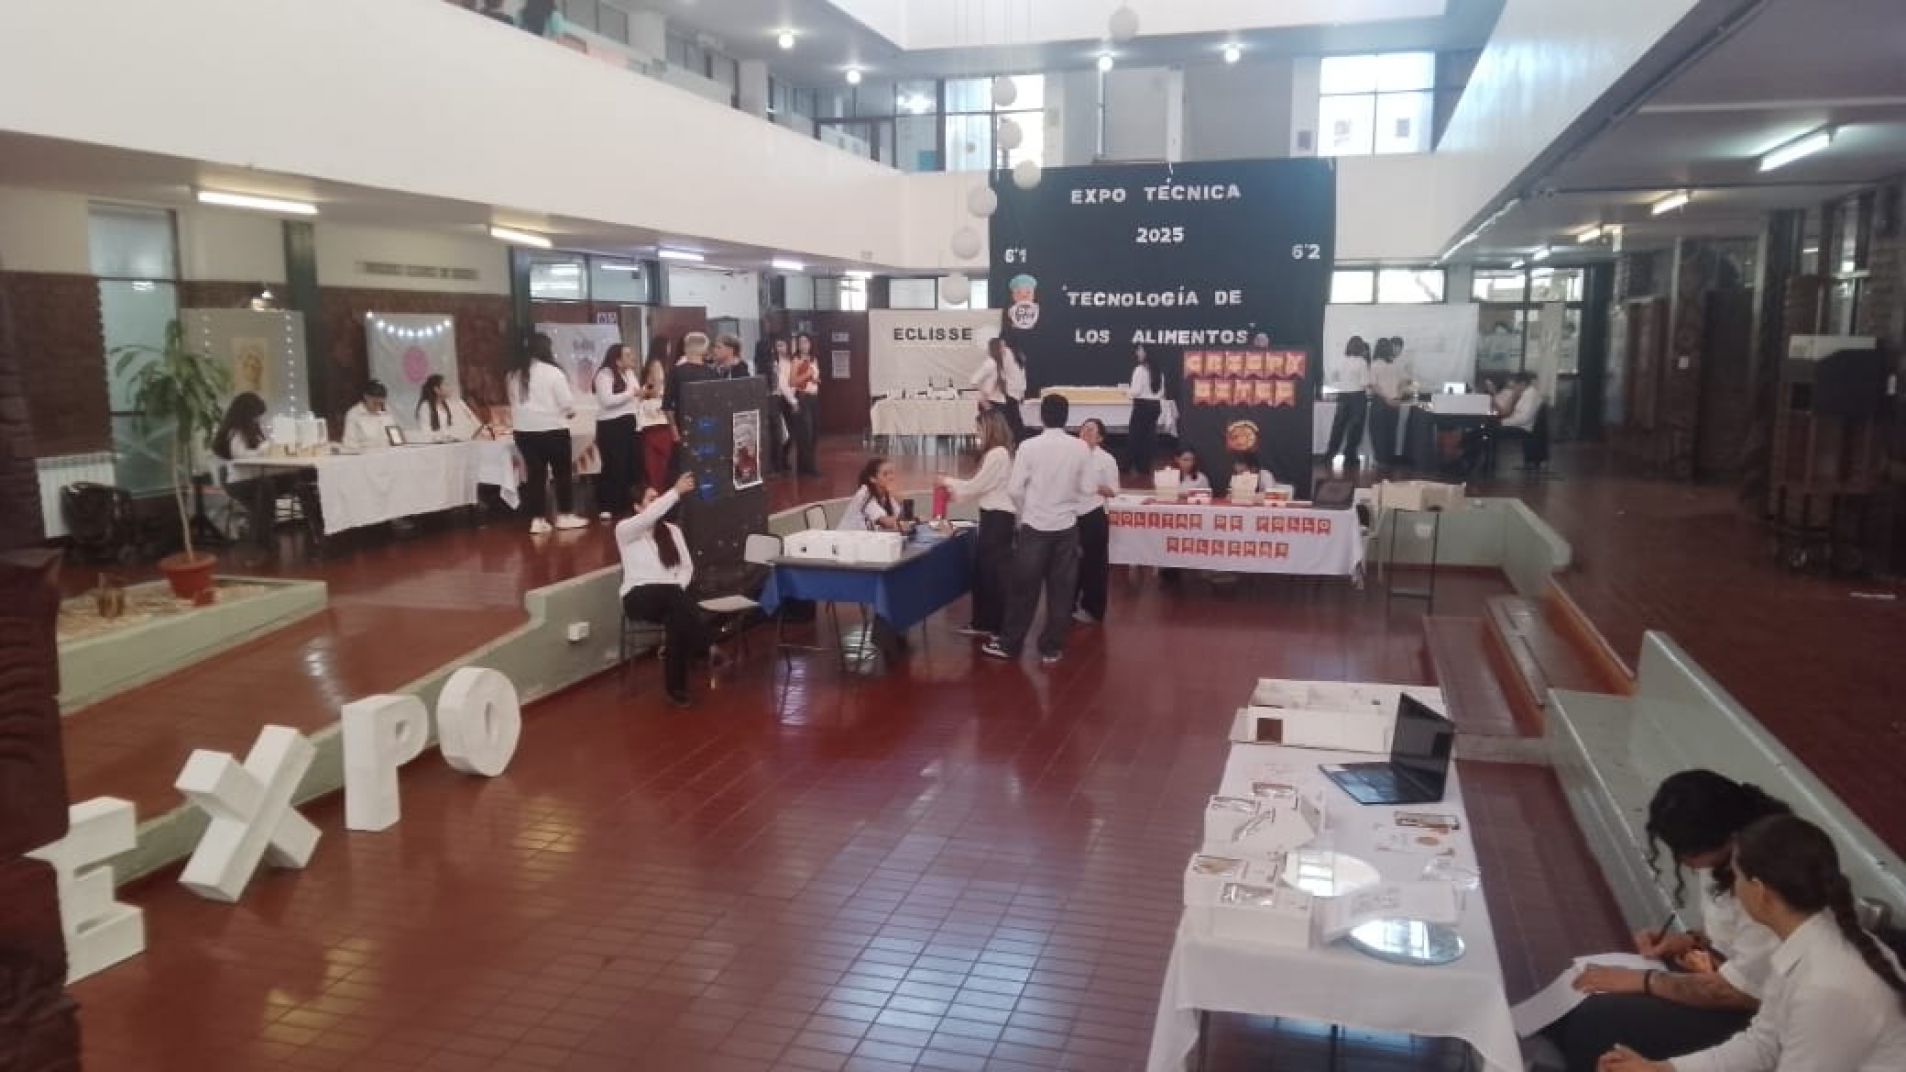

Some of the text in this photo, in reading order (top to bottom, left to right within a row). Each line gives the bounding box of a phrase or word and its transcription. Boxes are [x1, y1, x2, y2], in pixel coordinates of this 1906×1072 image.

[1071, 177, 1241, 205] EXPO TÉCNICA
[1135, 227, 1185, 243] 2025
[1214, 289, 1243, 306] DE
[893, 327, 973, 341] ECLISSE
[1074, 328, 1110, 344] LOS
[23, 665, 522, 987] EXPO
